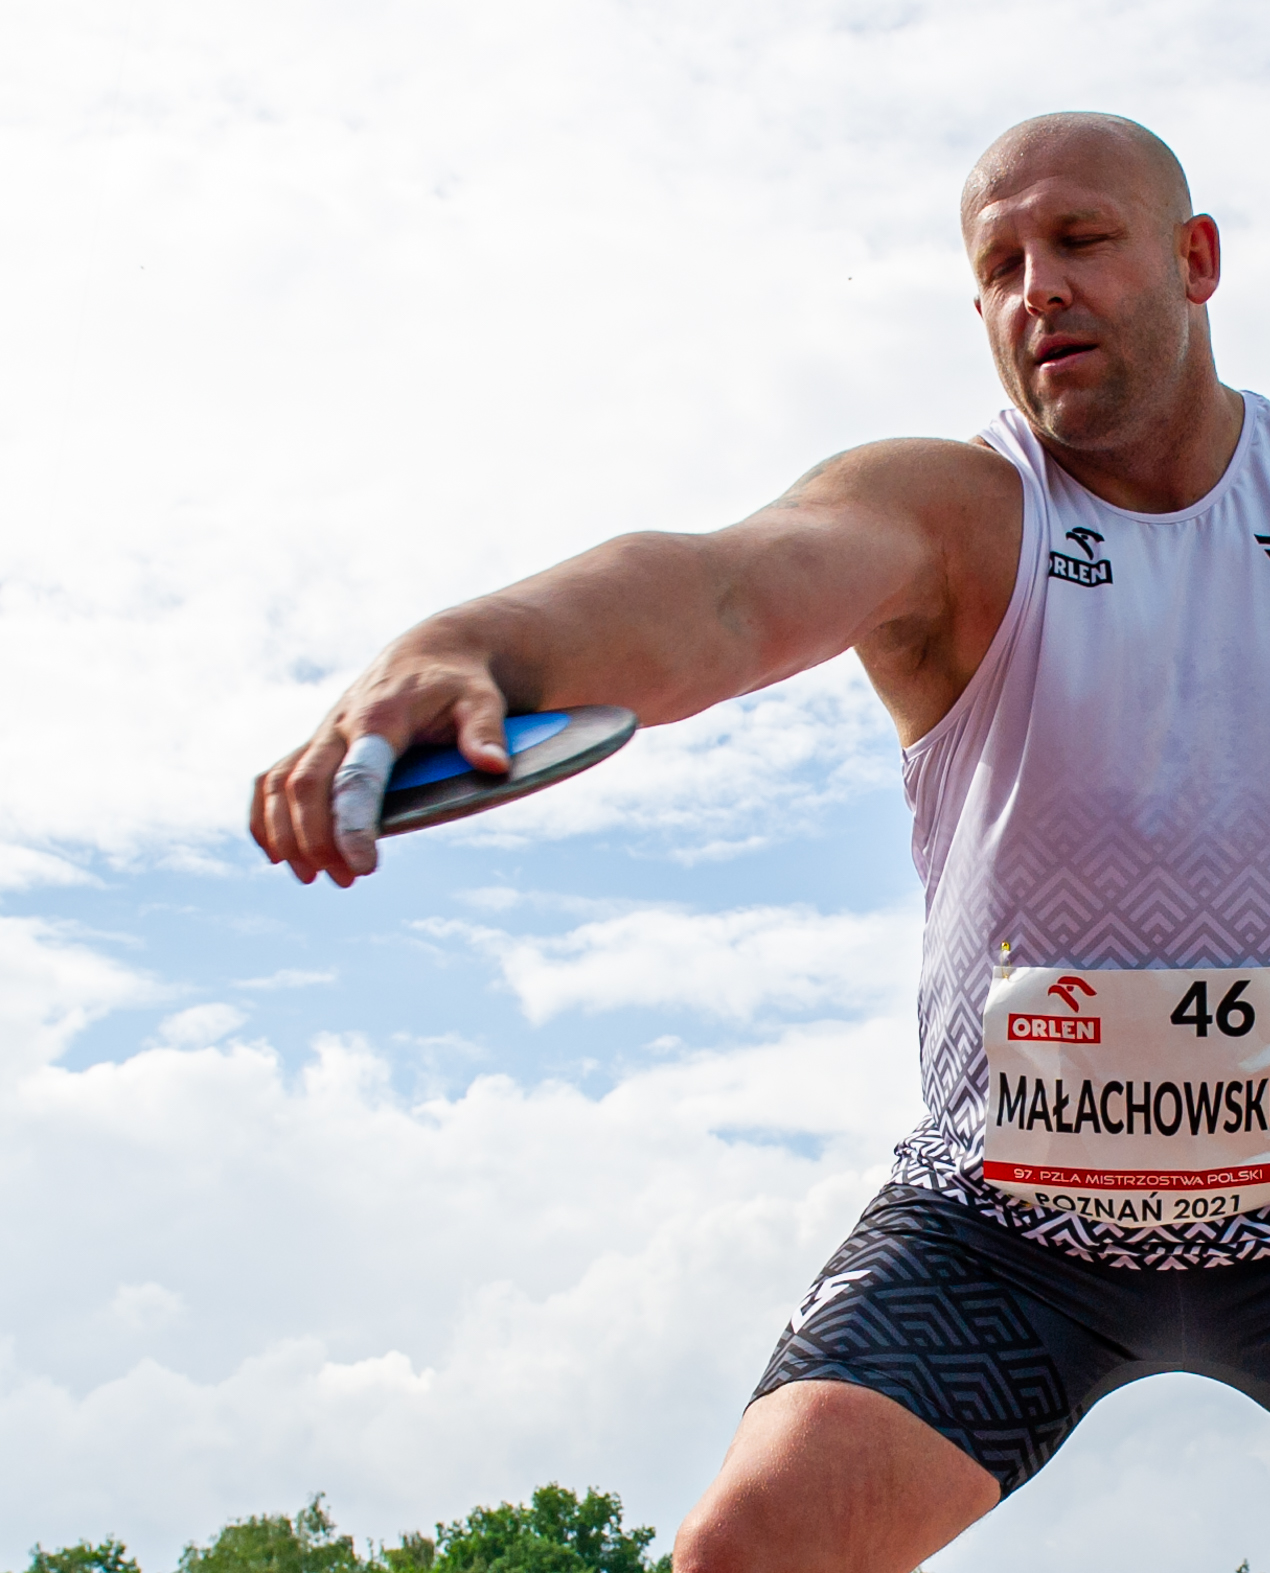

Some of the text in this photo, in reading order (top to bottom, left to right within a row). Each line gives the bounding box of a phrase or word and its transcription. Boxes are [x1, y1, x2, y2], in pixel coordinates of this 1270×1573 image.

[1049, 556, 1107, 584] RLEN
[1170, 980, 1255, 1038] 46
[1012, 1017, 1095, 1040] ORLEN
[1013, 1168, 1263, 1186] 97. PZLA MISTRZOSTWA POLSKI
[1035, 1191, 1241, 1222] POZNAŃ 2021
